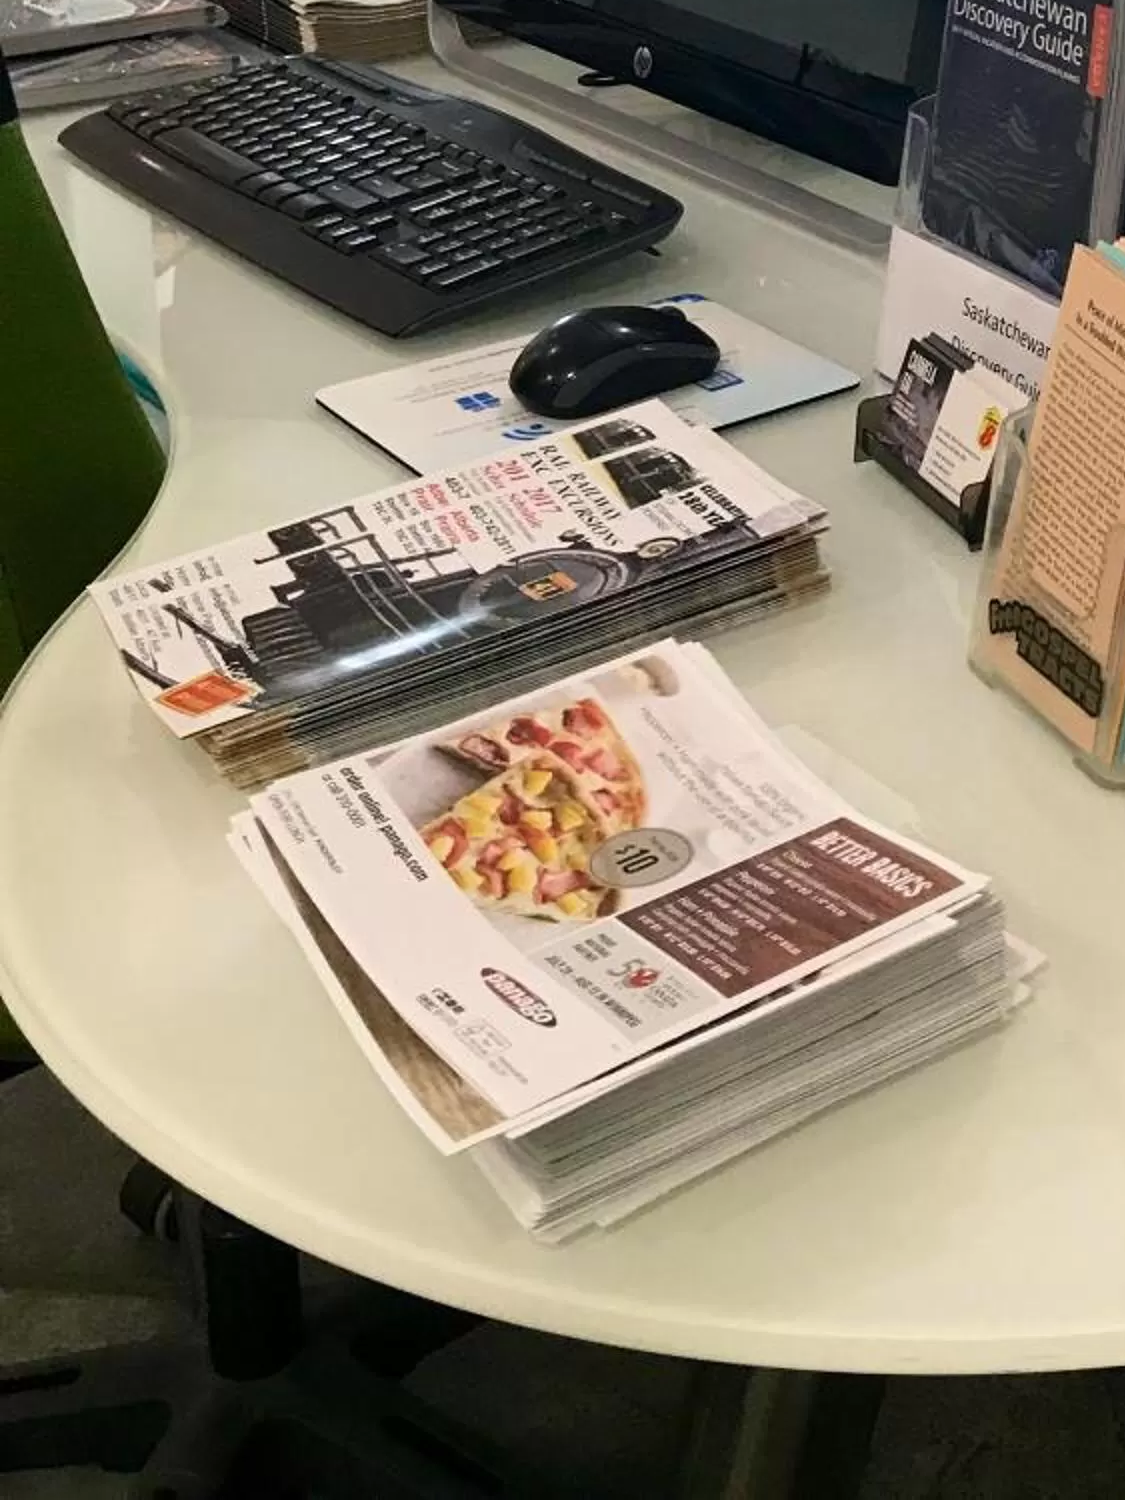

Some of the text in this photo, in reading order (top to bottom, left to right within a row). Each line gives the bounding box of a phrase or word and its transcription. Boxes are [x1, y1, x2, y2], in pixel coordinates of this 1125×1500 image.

[1032, 23, 1084, 67] Guide
[522, 486, 563, 513] 2017
[548, 477, 622, 547] EXCURSIONS
[568, 471, 622, 521] RAILWAY
[1017, 629, 1099, 717] TRACTS
[1019, 606, 1102, 692] GOSPEL
[340, 767, 366, 792] order
[378, 823, 429, 883] panago.com
[615, 843, 660, 875] $10
[808, 829, 934, 899] BETTER BASICS
